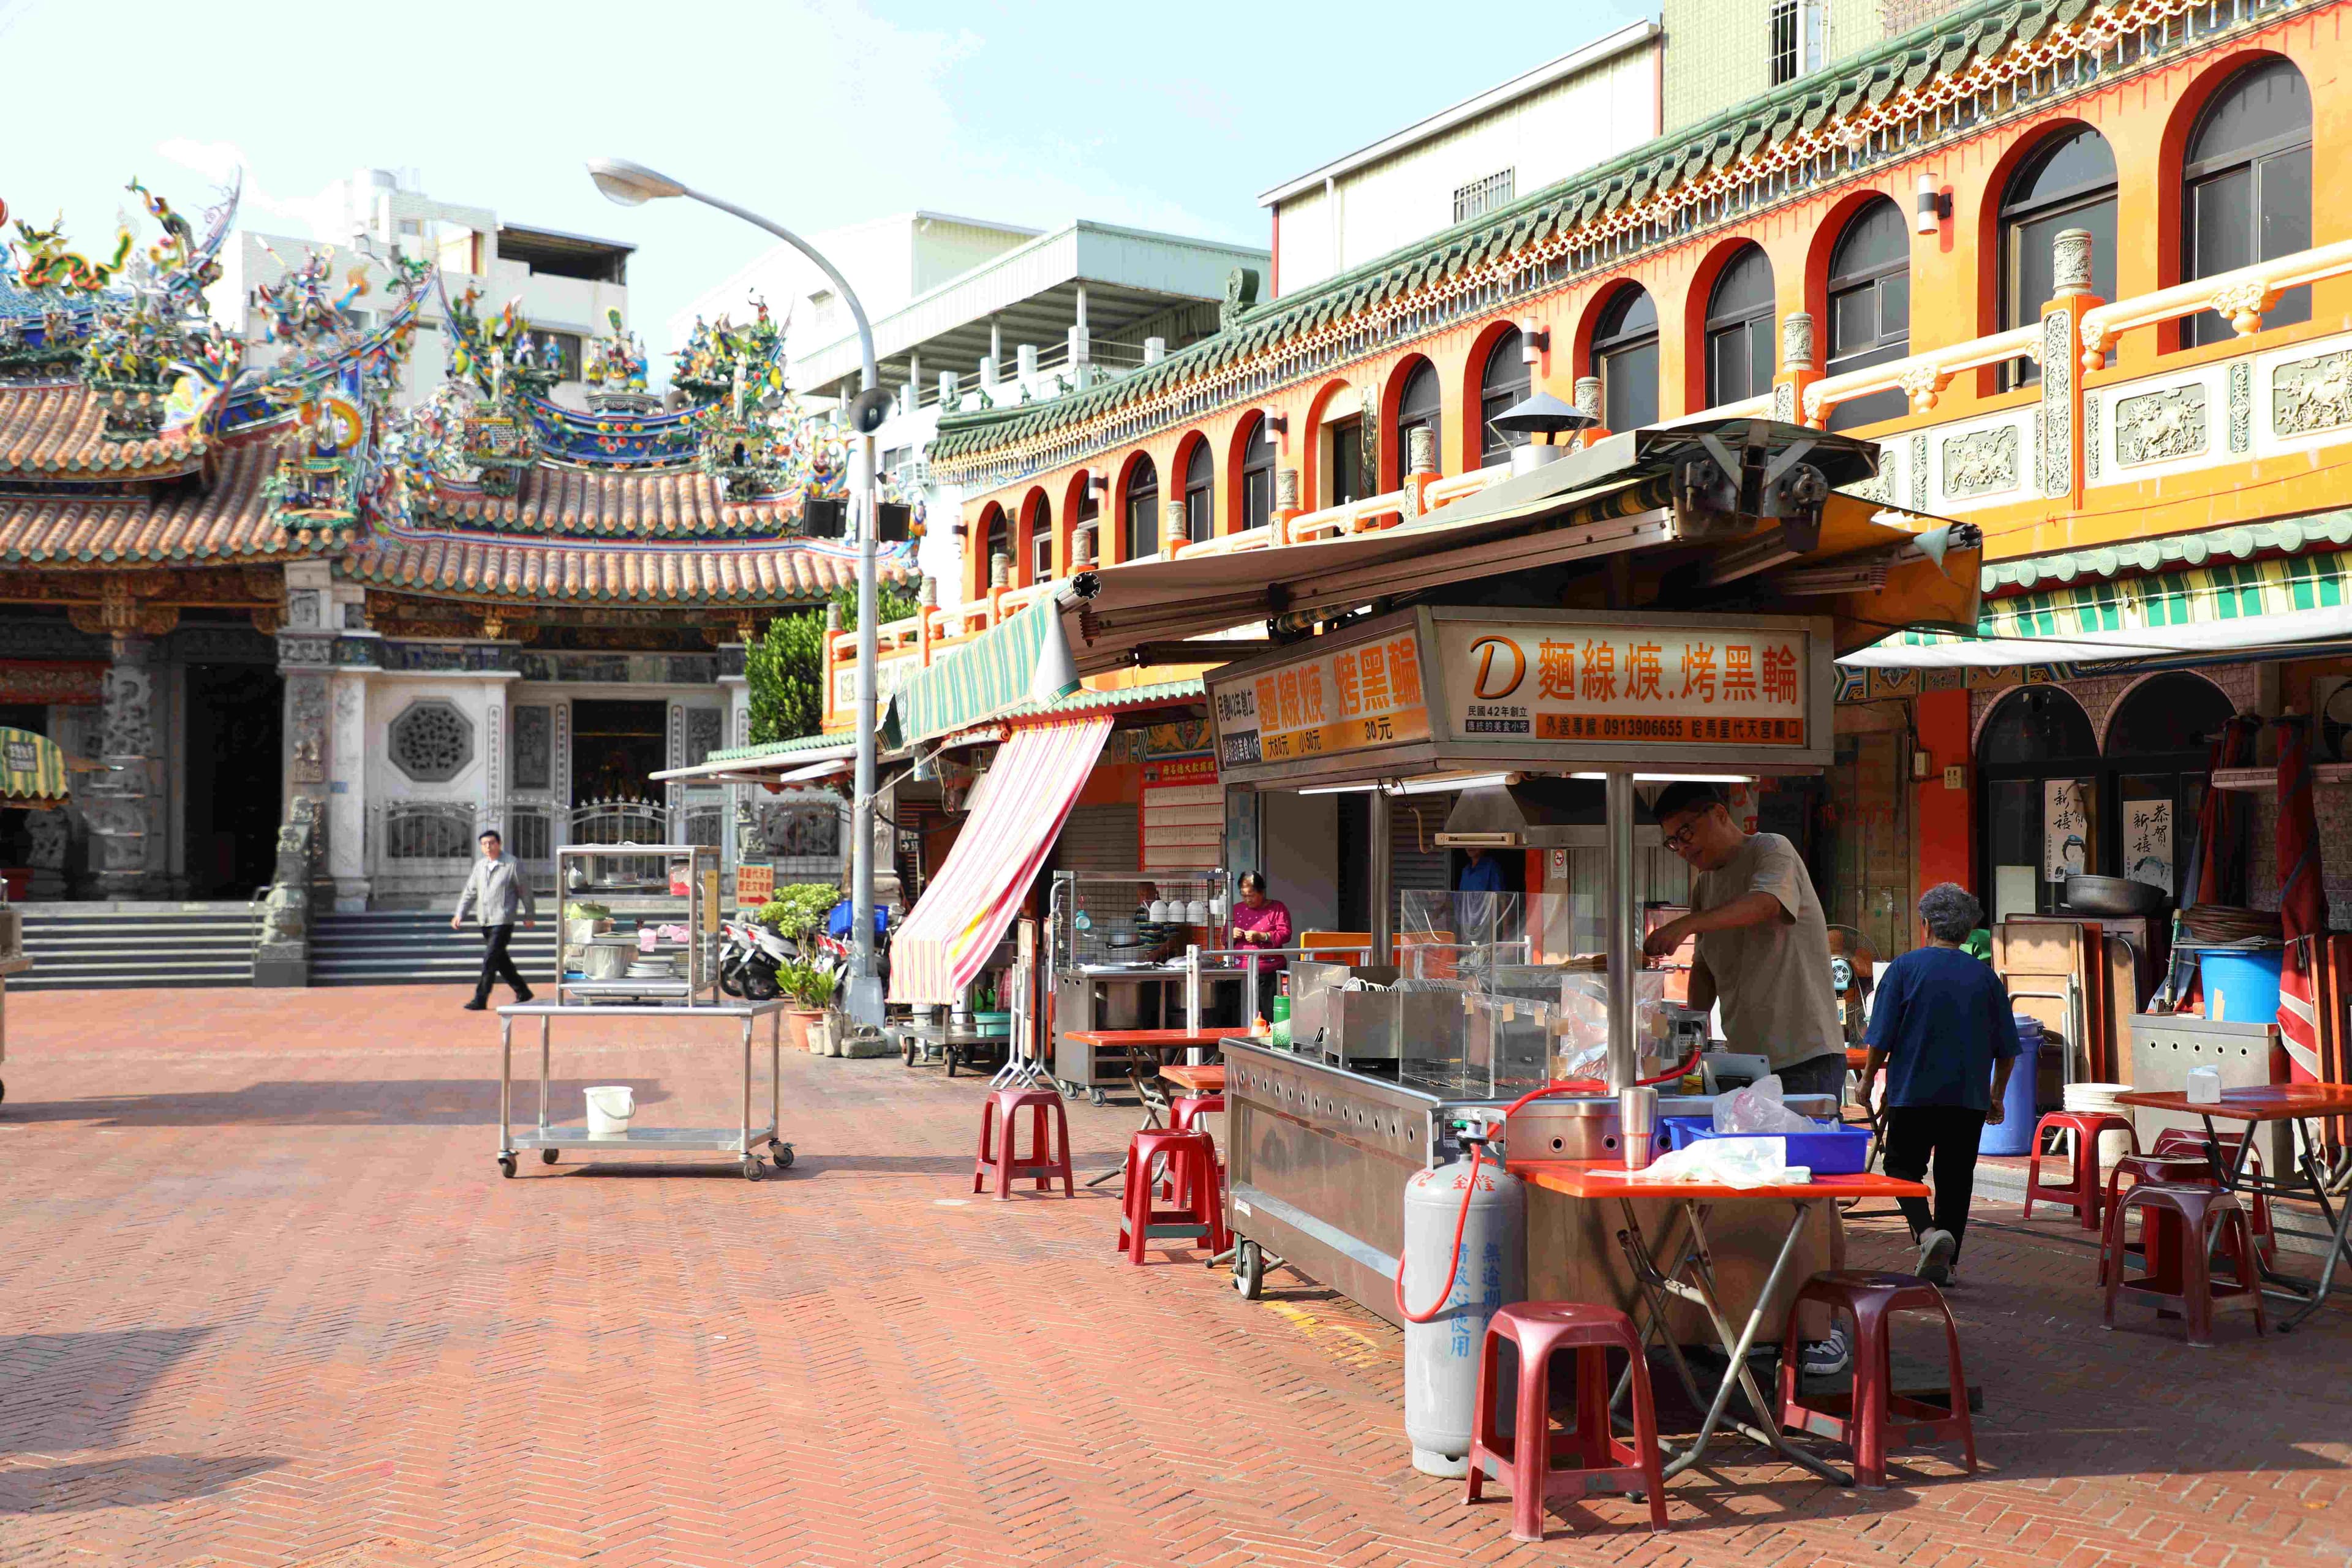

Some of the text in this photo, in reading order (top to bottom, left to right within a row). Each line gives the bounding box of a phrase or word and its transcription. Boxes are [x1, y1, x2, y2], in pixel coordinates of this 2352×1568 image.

[1468, 706, 1528, 718] 民國42年創立
[1468, 721, 1528, 733] 傳統的美食小吃
[1268, 736, 1289, 758] 大60元
[1298, 729, 1322, 754] 小50元
